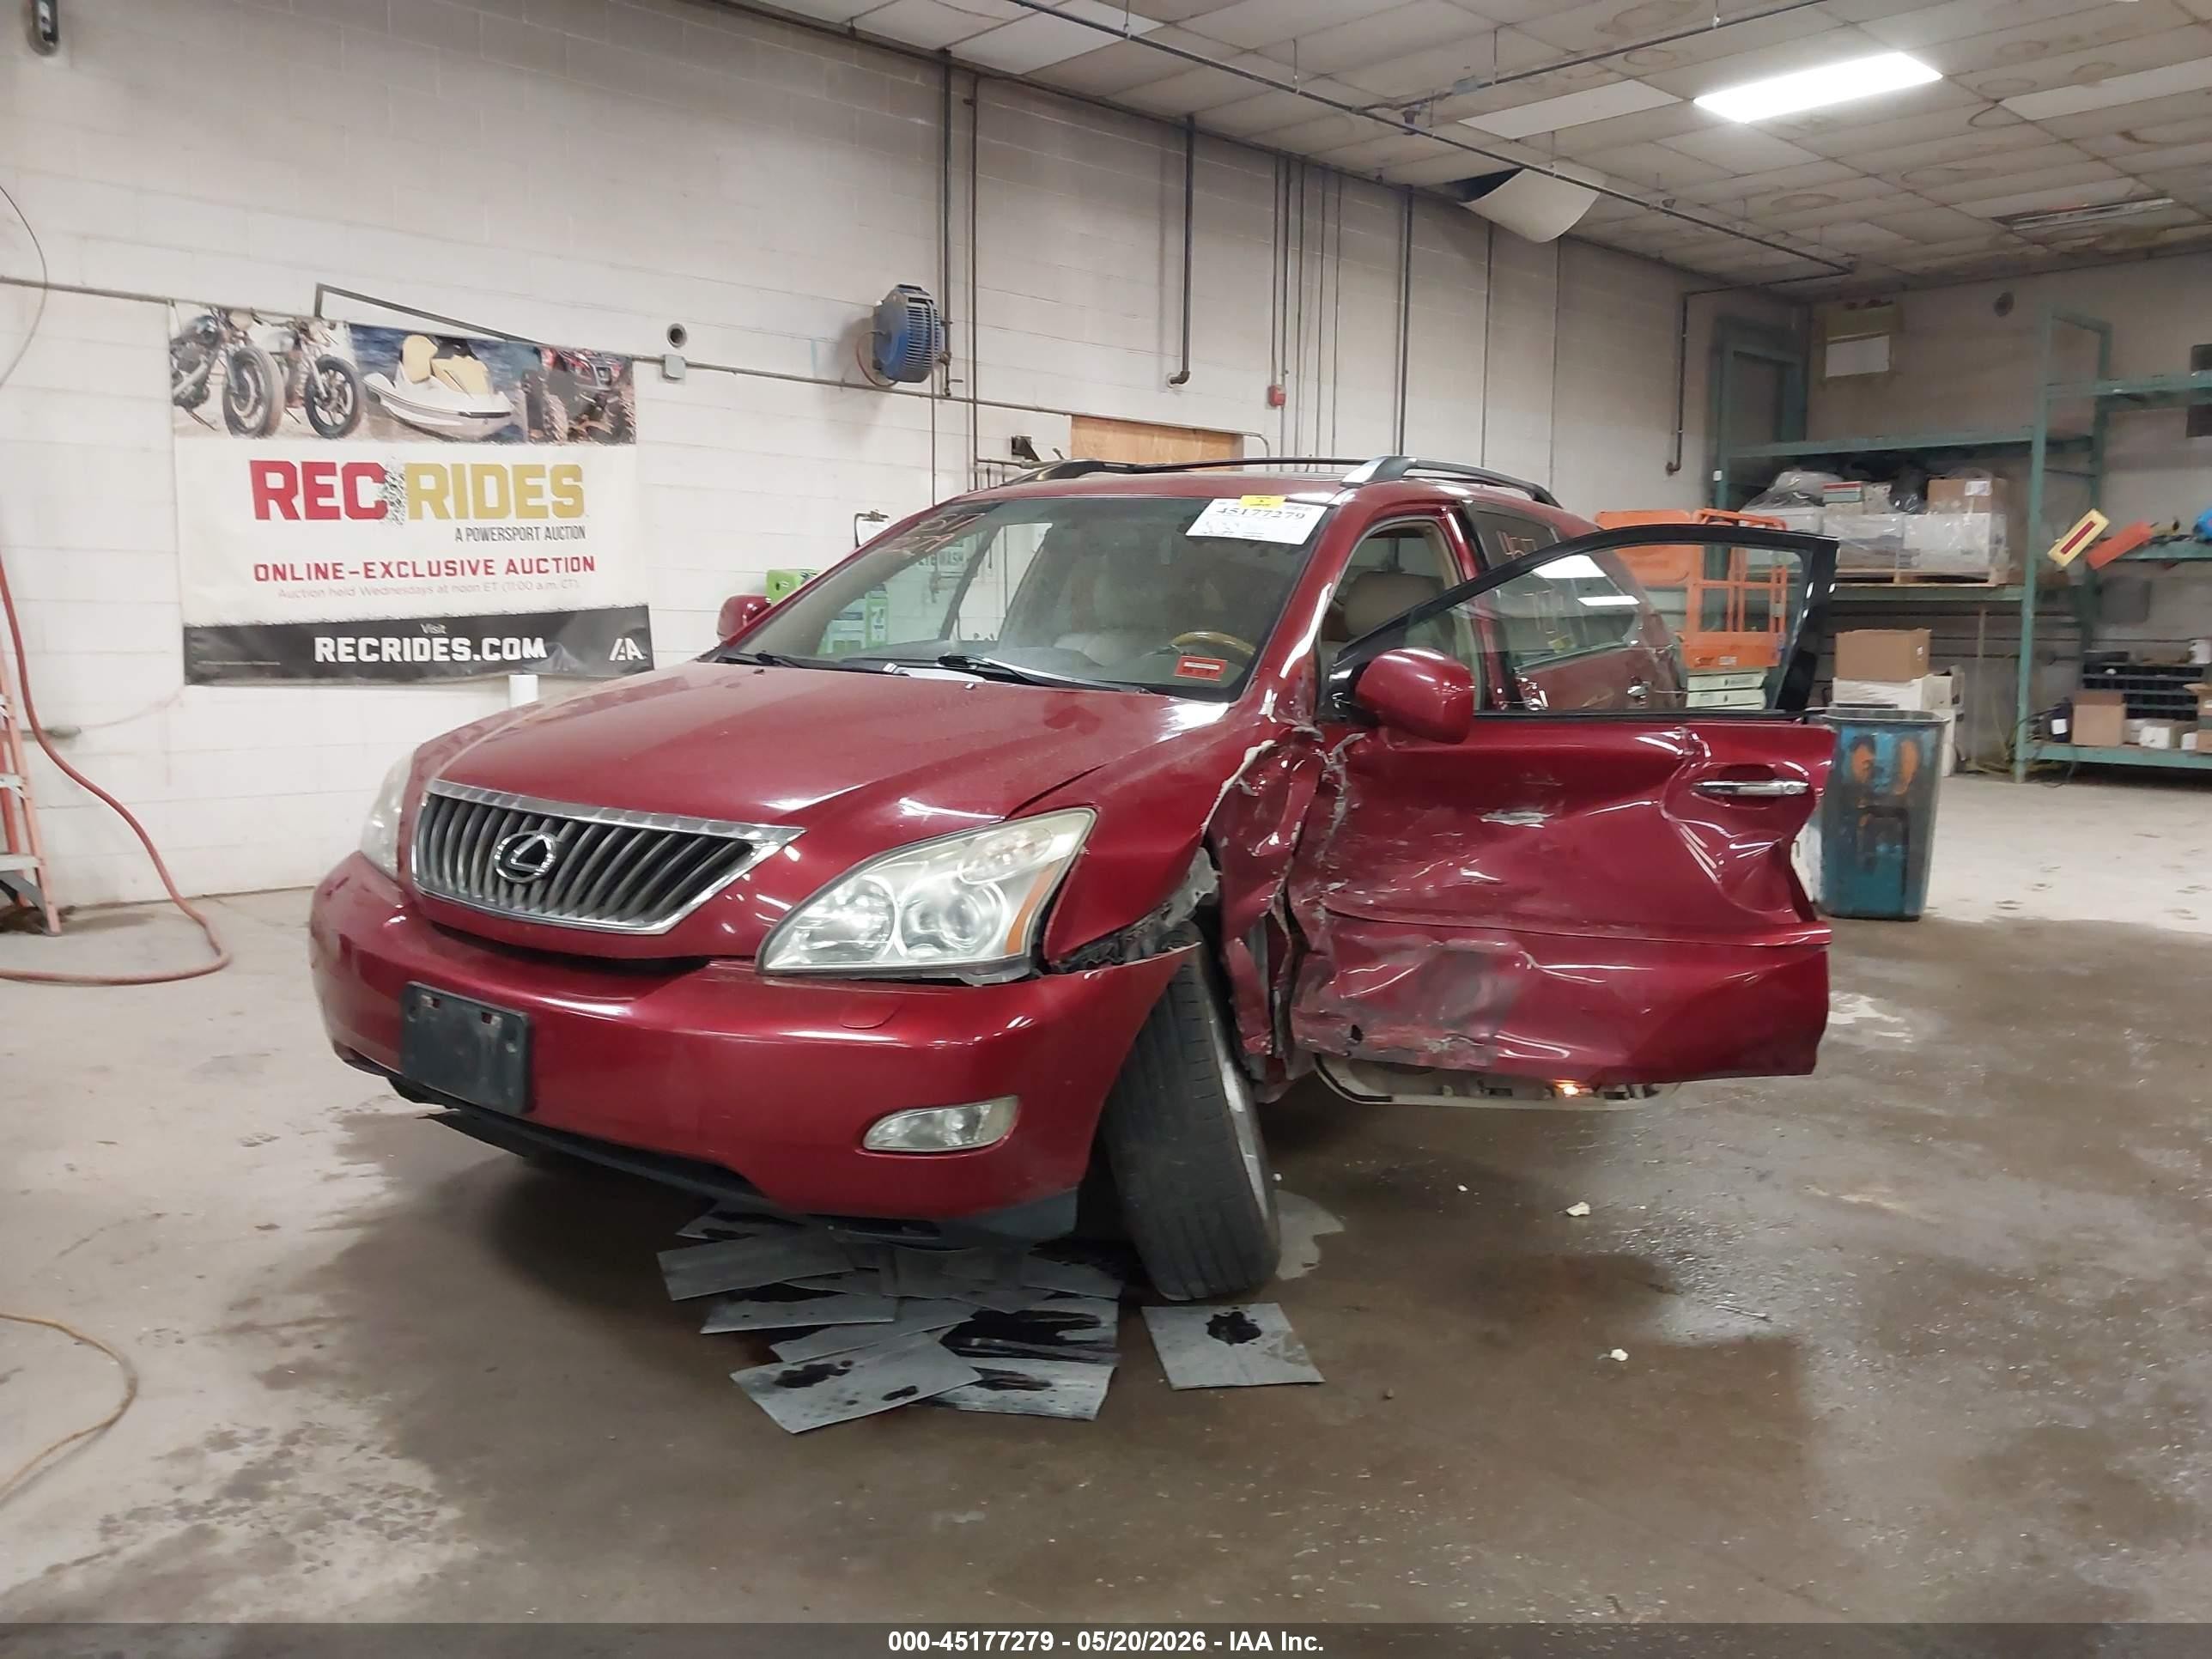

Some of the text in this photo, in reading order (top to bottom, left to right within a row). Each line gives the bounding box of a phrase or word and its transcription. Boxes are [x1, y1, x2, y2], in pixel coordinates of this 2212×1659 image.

[404, 463, 585, 520] RIDES
[455, 526, 586, 542] A POWERSPORT AUCTION
[253, 556, 595, 582] ONLINE-EXCLUSIVE AUCTION
[277, 588, 325, 599] Auction
[329, 585, 356, 597] held
[358, 584, 433, 598] Wednesdays
[437, 584, 448, 594] at
[452, 585, 479, 593] noon
[483, 582, 497, 592] ET
[420, 623, 447, 635] Visit
[314, 637, 548, 662] RECRIDES.COM
